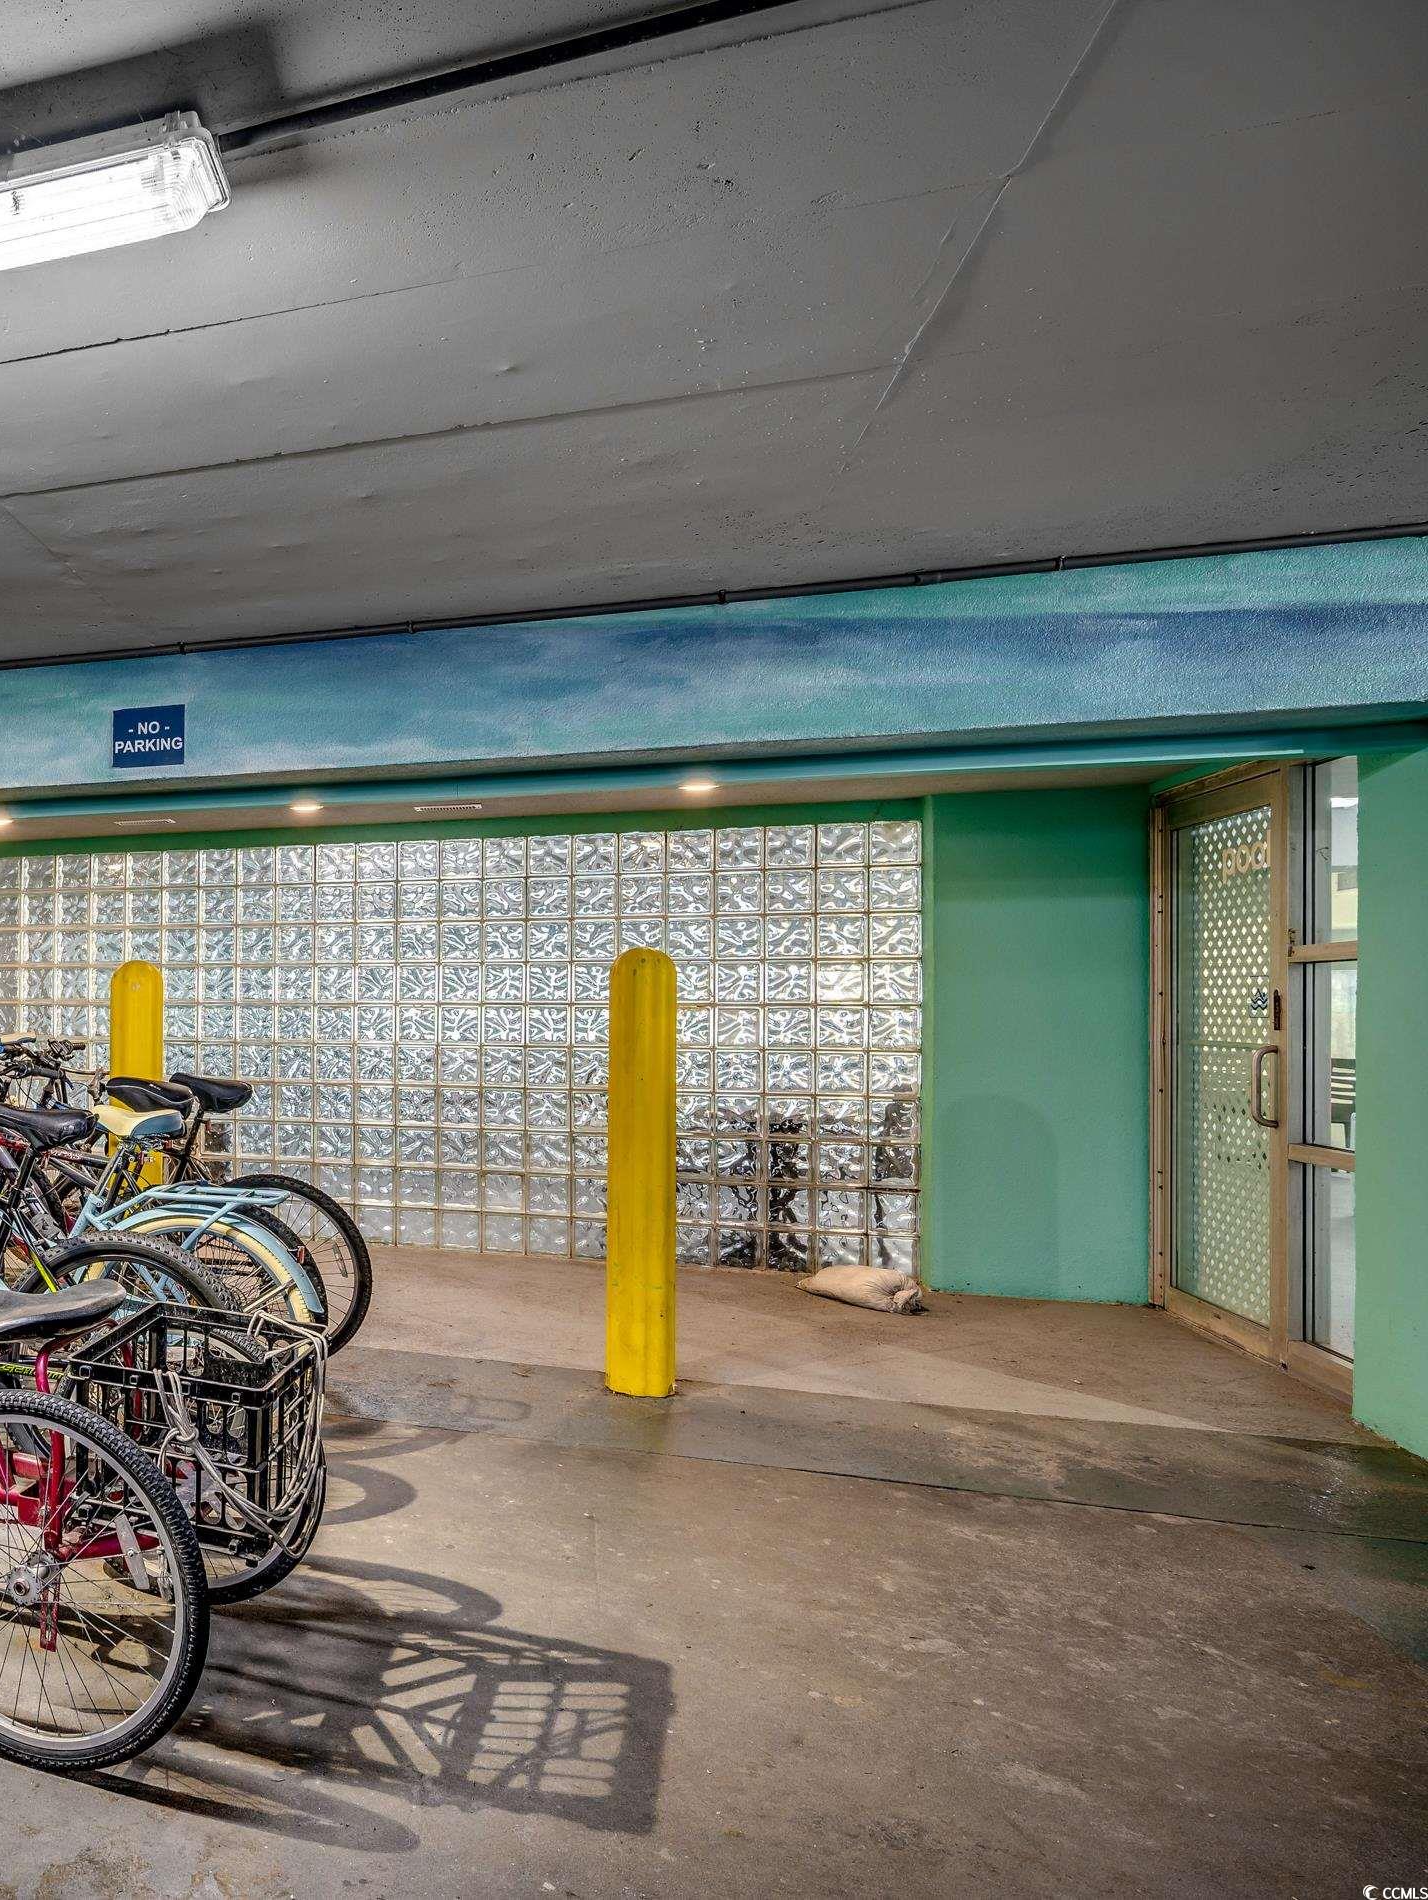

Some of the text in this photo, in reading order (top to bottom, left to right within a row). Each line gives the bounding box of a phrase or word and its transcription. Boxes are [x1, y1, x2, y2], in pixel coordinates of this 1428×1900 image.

[137, 721, 160, 735] NO
[114, 736, 183, 754] PARKING
[1222, 829, 1271, 885] pool
